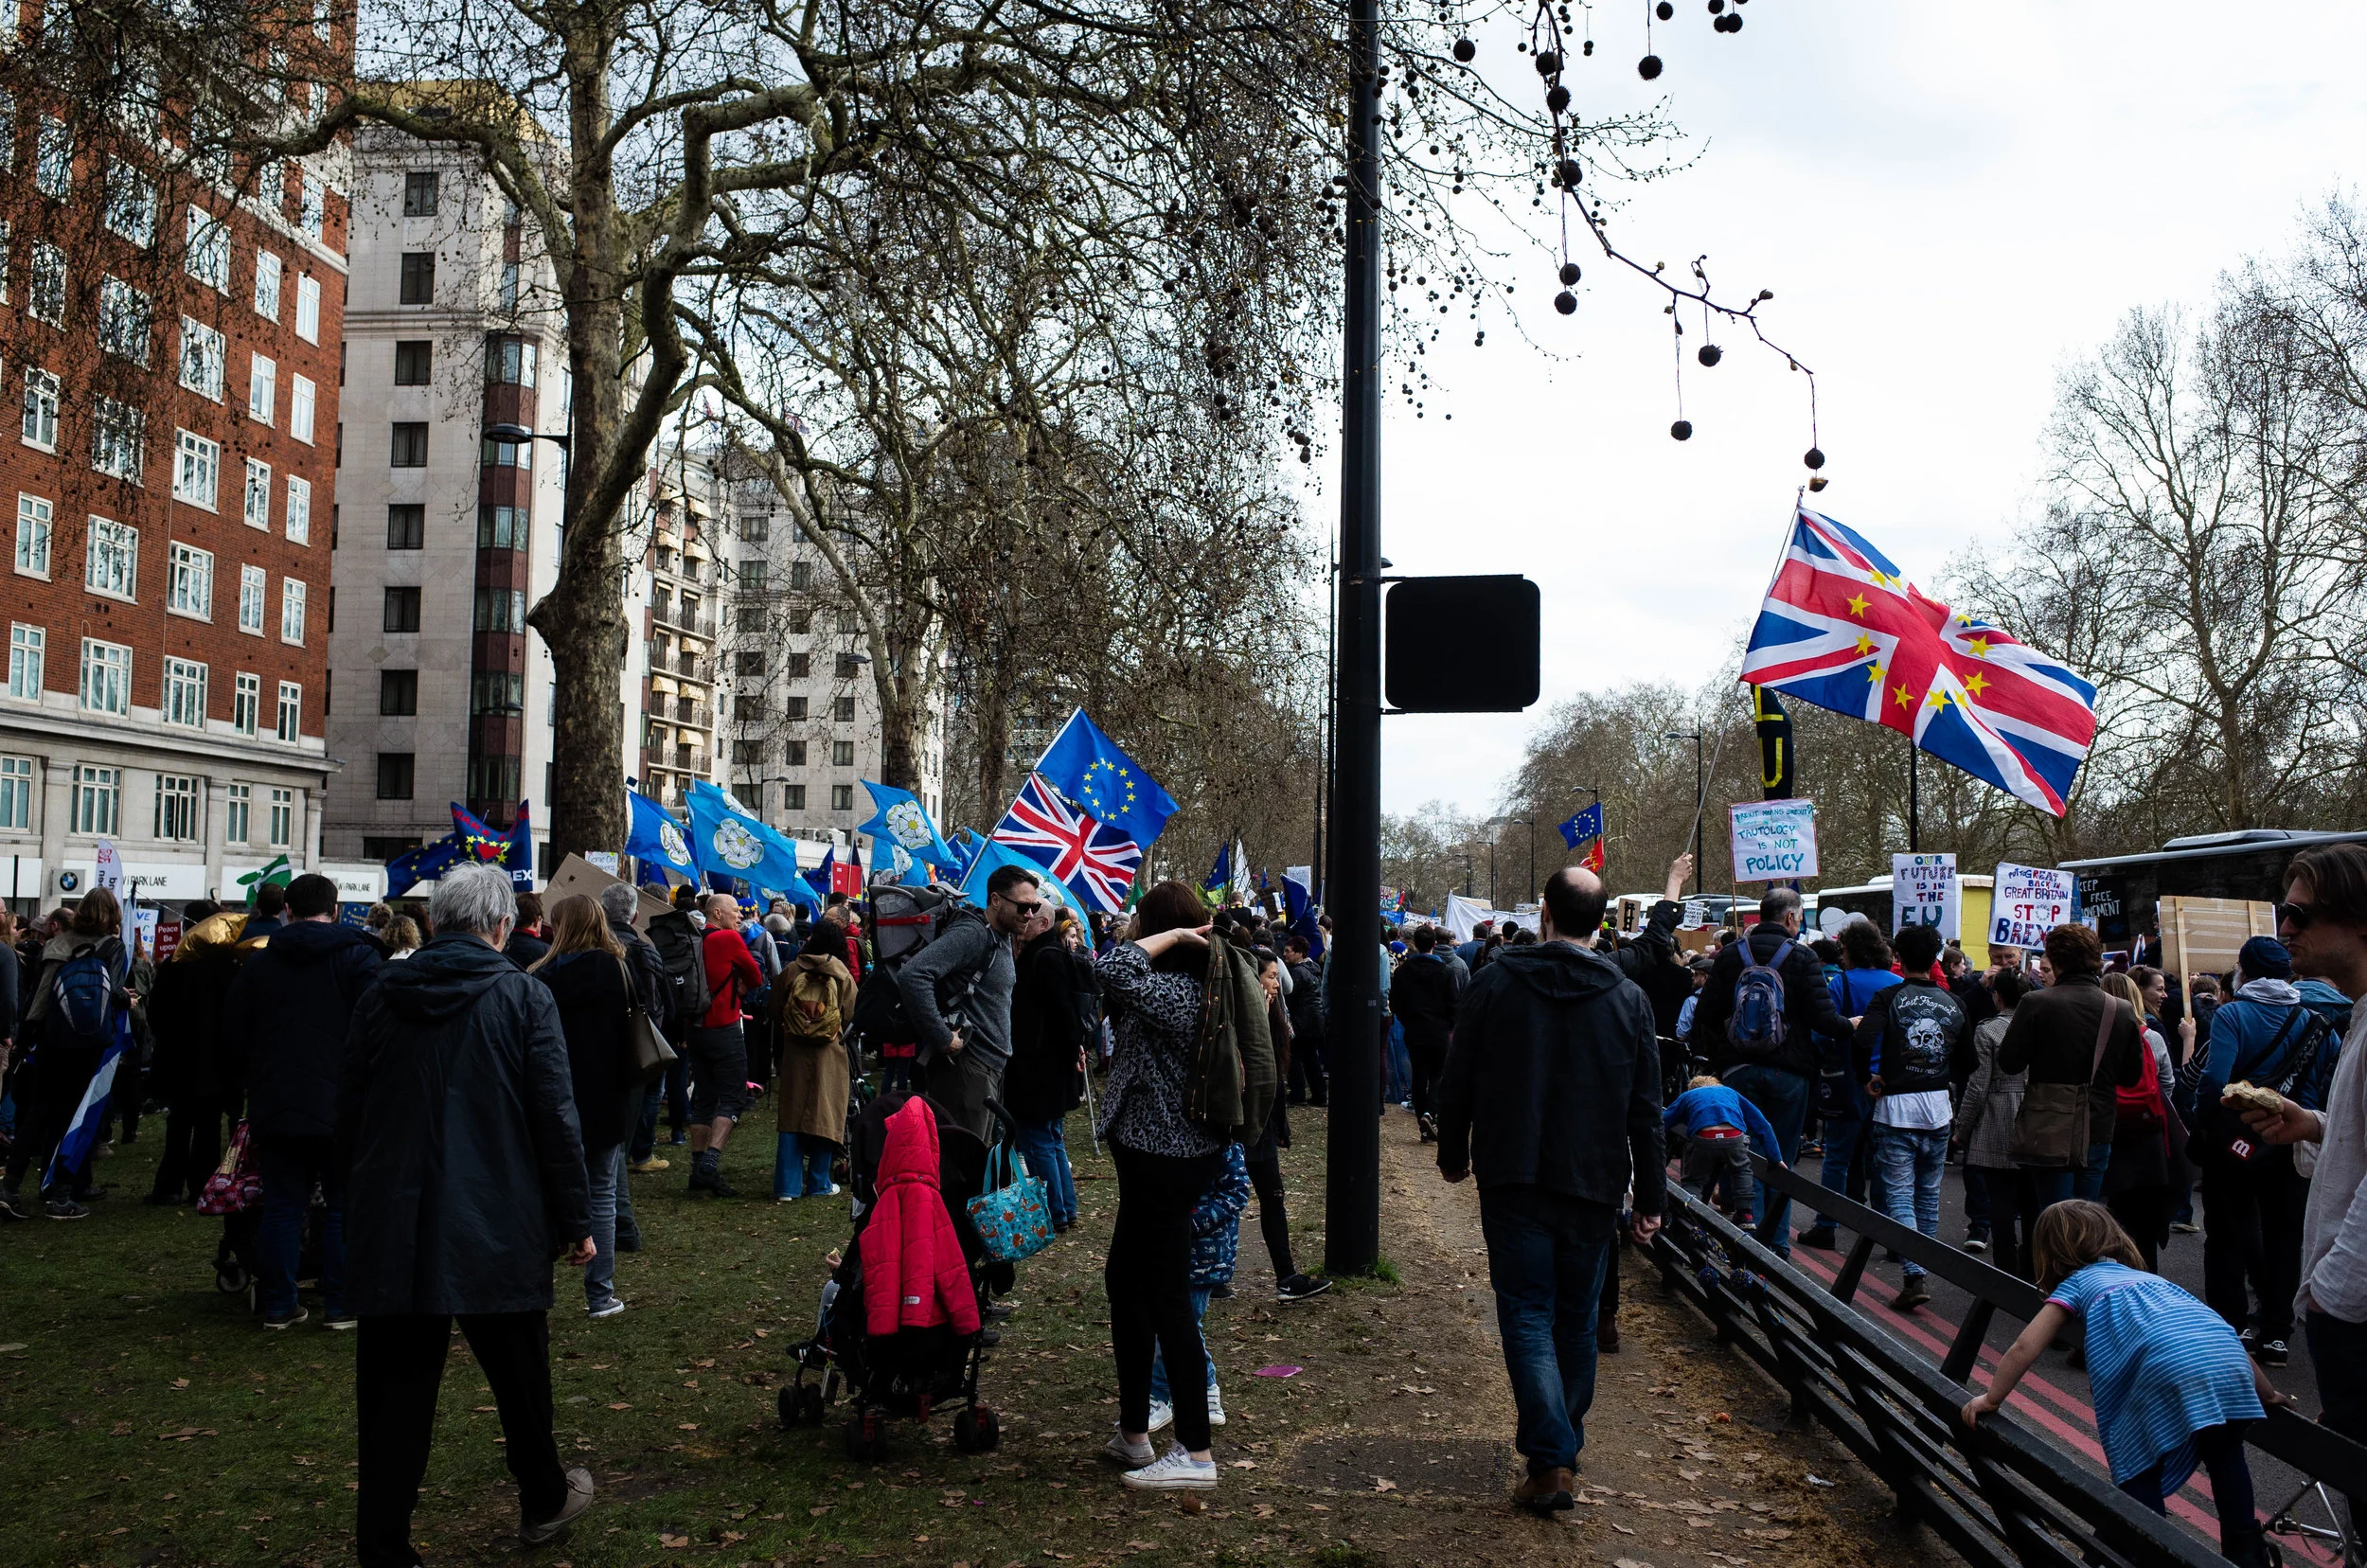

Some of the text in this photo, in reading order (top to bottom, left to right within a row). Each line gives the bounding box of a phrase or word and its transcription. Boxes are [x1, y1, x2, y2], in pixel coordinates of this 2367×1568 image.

[1735, 811, 1758, 822] BREXIT
[1787, 804, 1813, 815] BREXIT?
[1737, 825, 1796, 839] TAUTOLOGY
[1774, 839, 1798, 848] NOT
[1746, 853, 1804, 874] POLICY
[1914, 855, 1943, 865] OUR
[1900, 866, 1954, 881] FUTURE
[2026, 870, 2058, 882] GREAT
[131, 876, 148, 886] PARK
[150, 876, 167, 886] LANE
[2028, 880, 2051, 888] BACK
[2077, 879, 2098, 892] KEEP
[1916, 892, 1944, 902] THE
[2004, 887, 2034, 900] GREAT
[2091, 890, 2112, 902] FREE
[1901, 905, 1943, 928] EU
[2014, 904, 2060, 922] STOP
[1995, 918, 2056, 947] BREX
[1898, 996, 1919, 1009] Lost
